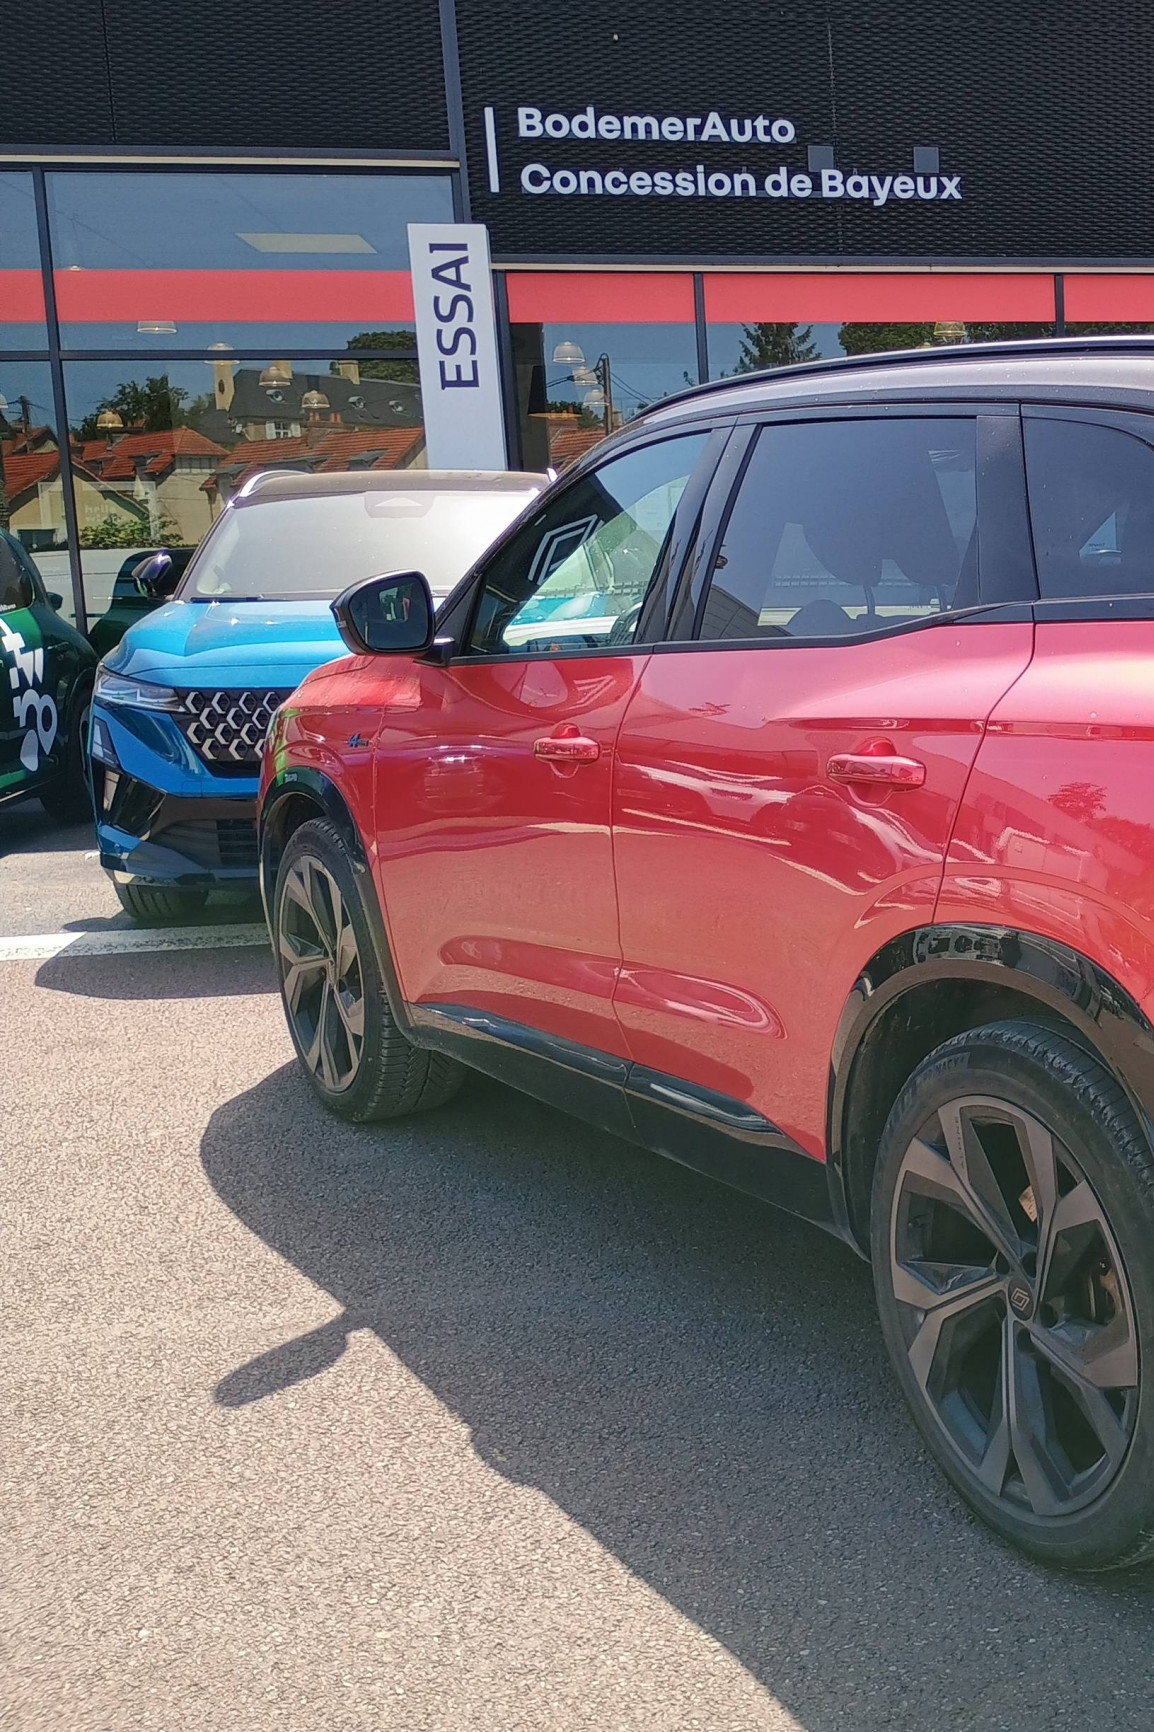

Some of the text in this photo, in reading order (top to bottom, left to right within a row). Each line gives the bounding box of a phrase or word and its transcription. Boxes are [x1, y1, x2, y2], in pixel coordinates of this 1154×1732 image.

[517, 106, 796, 143] BodemerAuto
[520, 163, 963, 206] Concession de Bayeux
[428, 243, 480, 391] ESSAI
